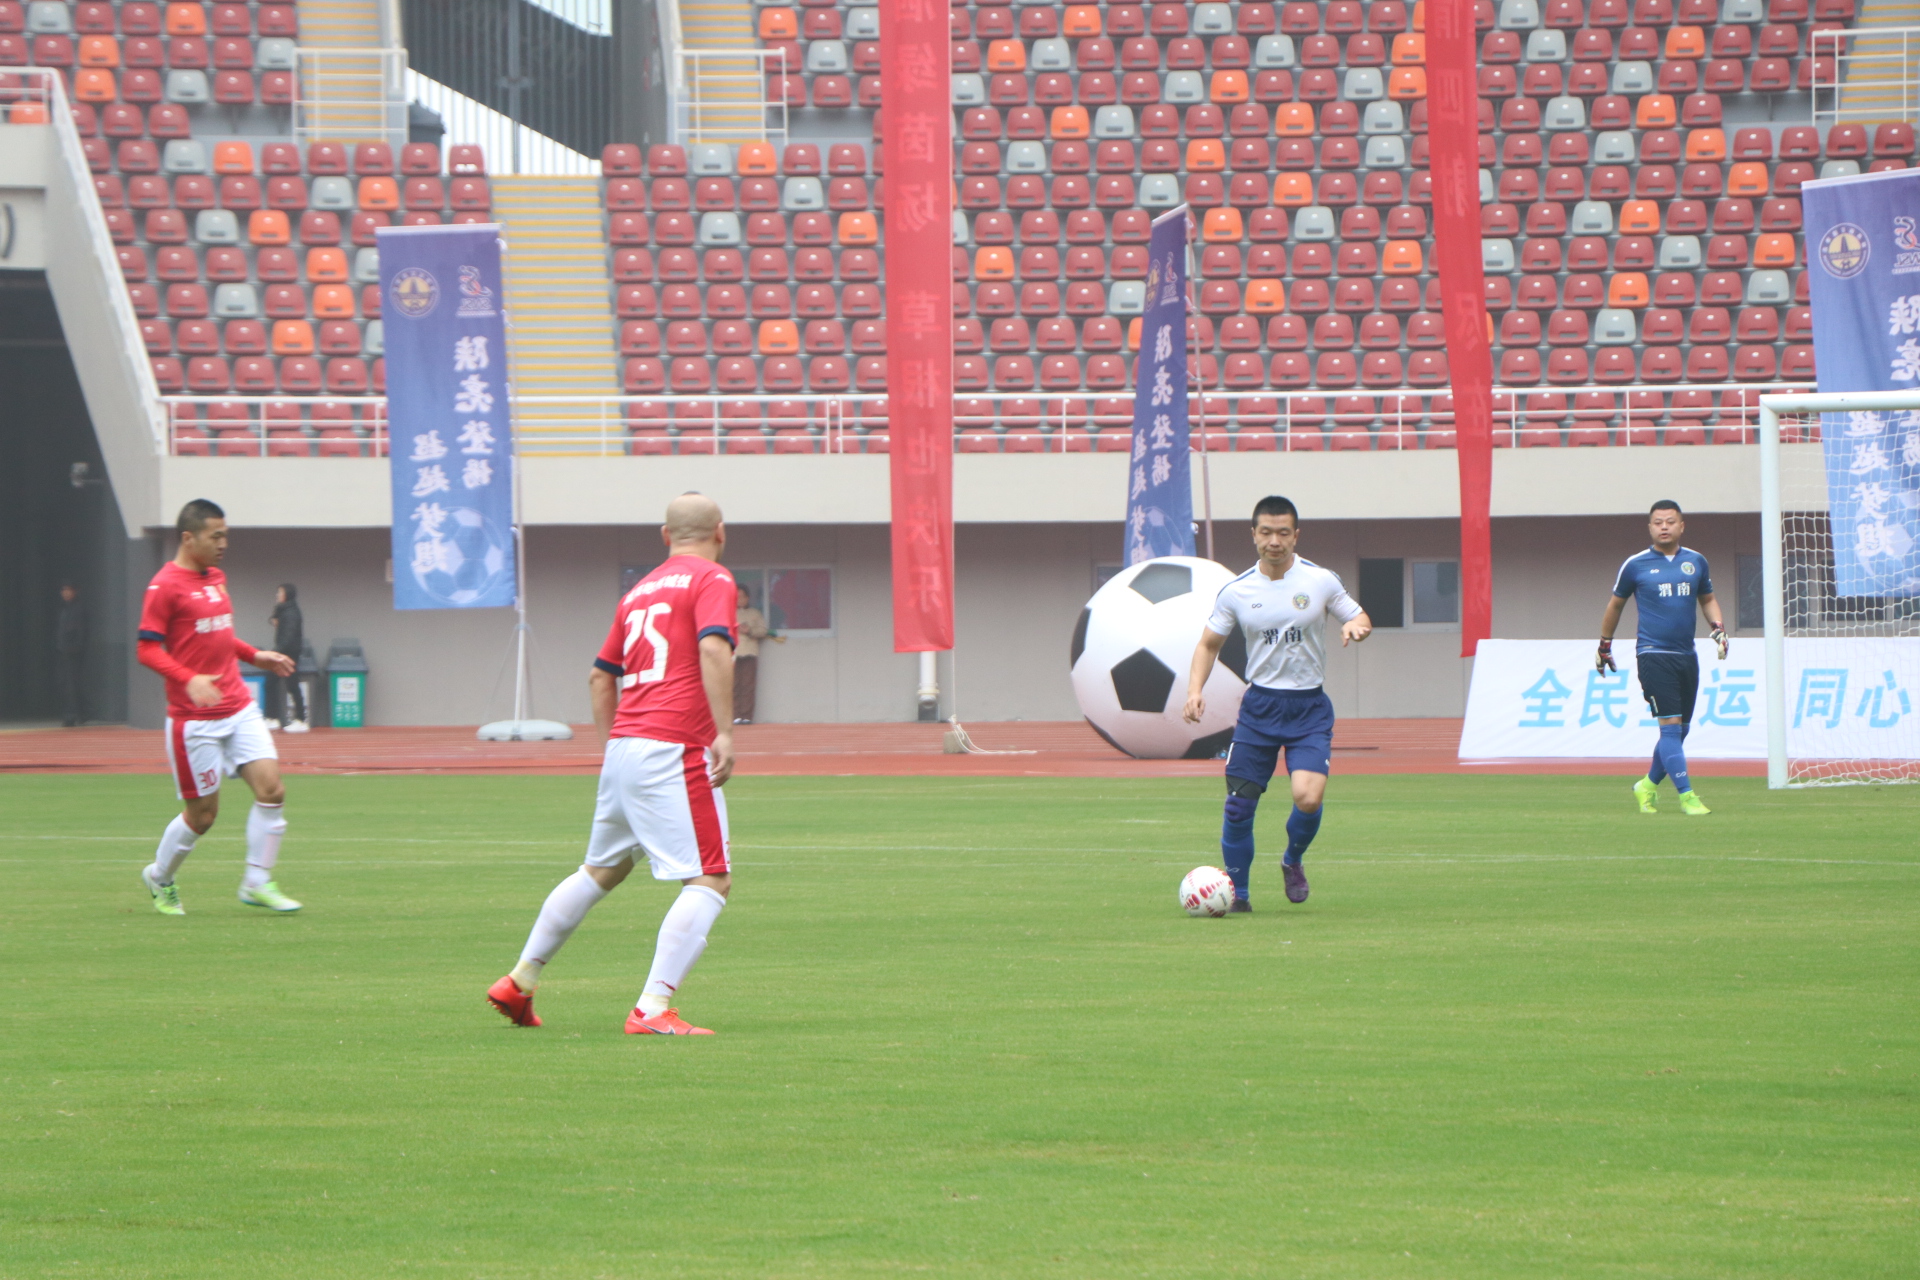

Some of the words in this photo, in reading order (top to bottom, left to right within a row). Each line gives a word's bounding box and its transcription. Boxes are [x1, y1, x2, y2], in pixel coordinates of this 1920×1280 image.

[1658, 581, 1691, 598] 渭南
[622, 601, 673, 690] 25
[1262, 625, 1303, 646] 渭南
[1517, 667, 1758, 729] 全民运
[1793, 667, 1912, 730] 同心
[198, 768, 218, 790] 30
